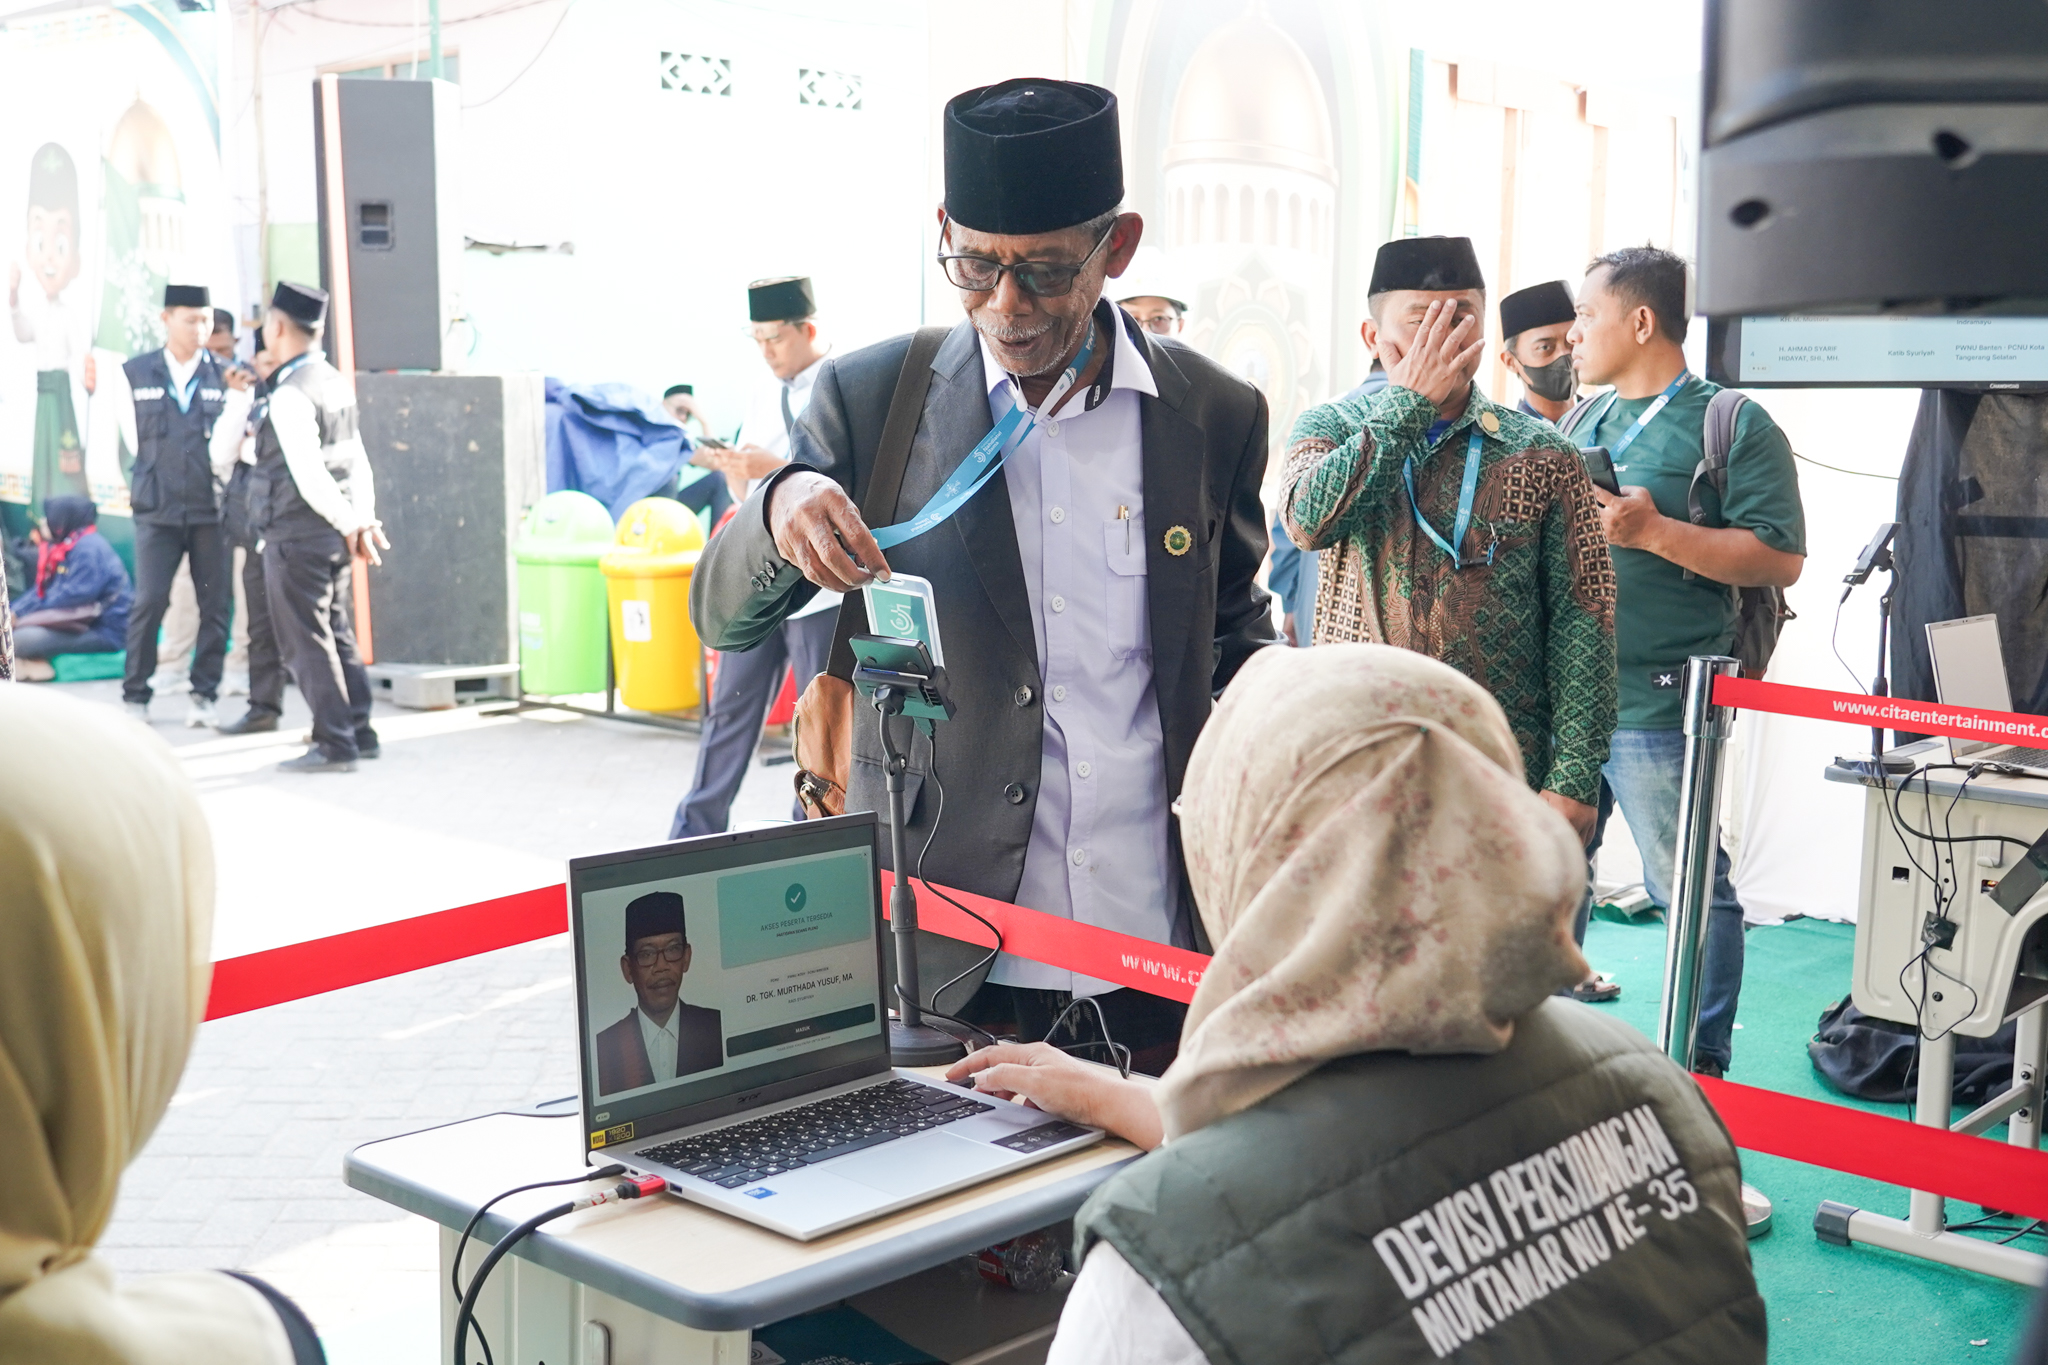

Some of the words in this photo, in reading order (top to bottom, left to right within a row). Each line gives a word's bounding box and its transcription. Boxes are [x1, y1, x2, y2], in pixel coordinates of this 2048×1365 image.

[1955, 354, 1991, 362] Tangerang
[760, 922, 780, 932] AKSES
[780, 917, 806, 928] PESERTA
[806, 912, 833, 922] TERSEDIA
[746, 994, 758, 1004] DR.
[760, 990, 776, 1000] TGK.
[777, 981, 816, 996] MURTHADA
[817, 975, 841, 987] YUSUF,
[842, 972, 854, 982] MA
[795, 1026, 811, 1034] MASUK
[609, 1126, 626, 1136] 1920
[1372, 1182, 1508, 1300] DEVISI
[1489, 1103, 1680, 1242] PERSIDANGAN
[1411, 1233, 1578, 1359] MUKTAMAR
[1560, 1214, 1612, 1273] NU
[1602, 1168, 1699, 1251] KE-35
